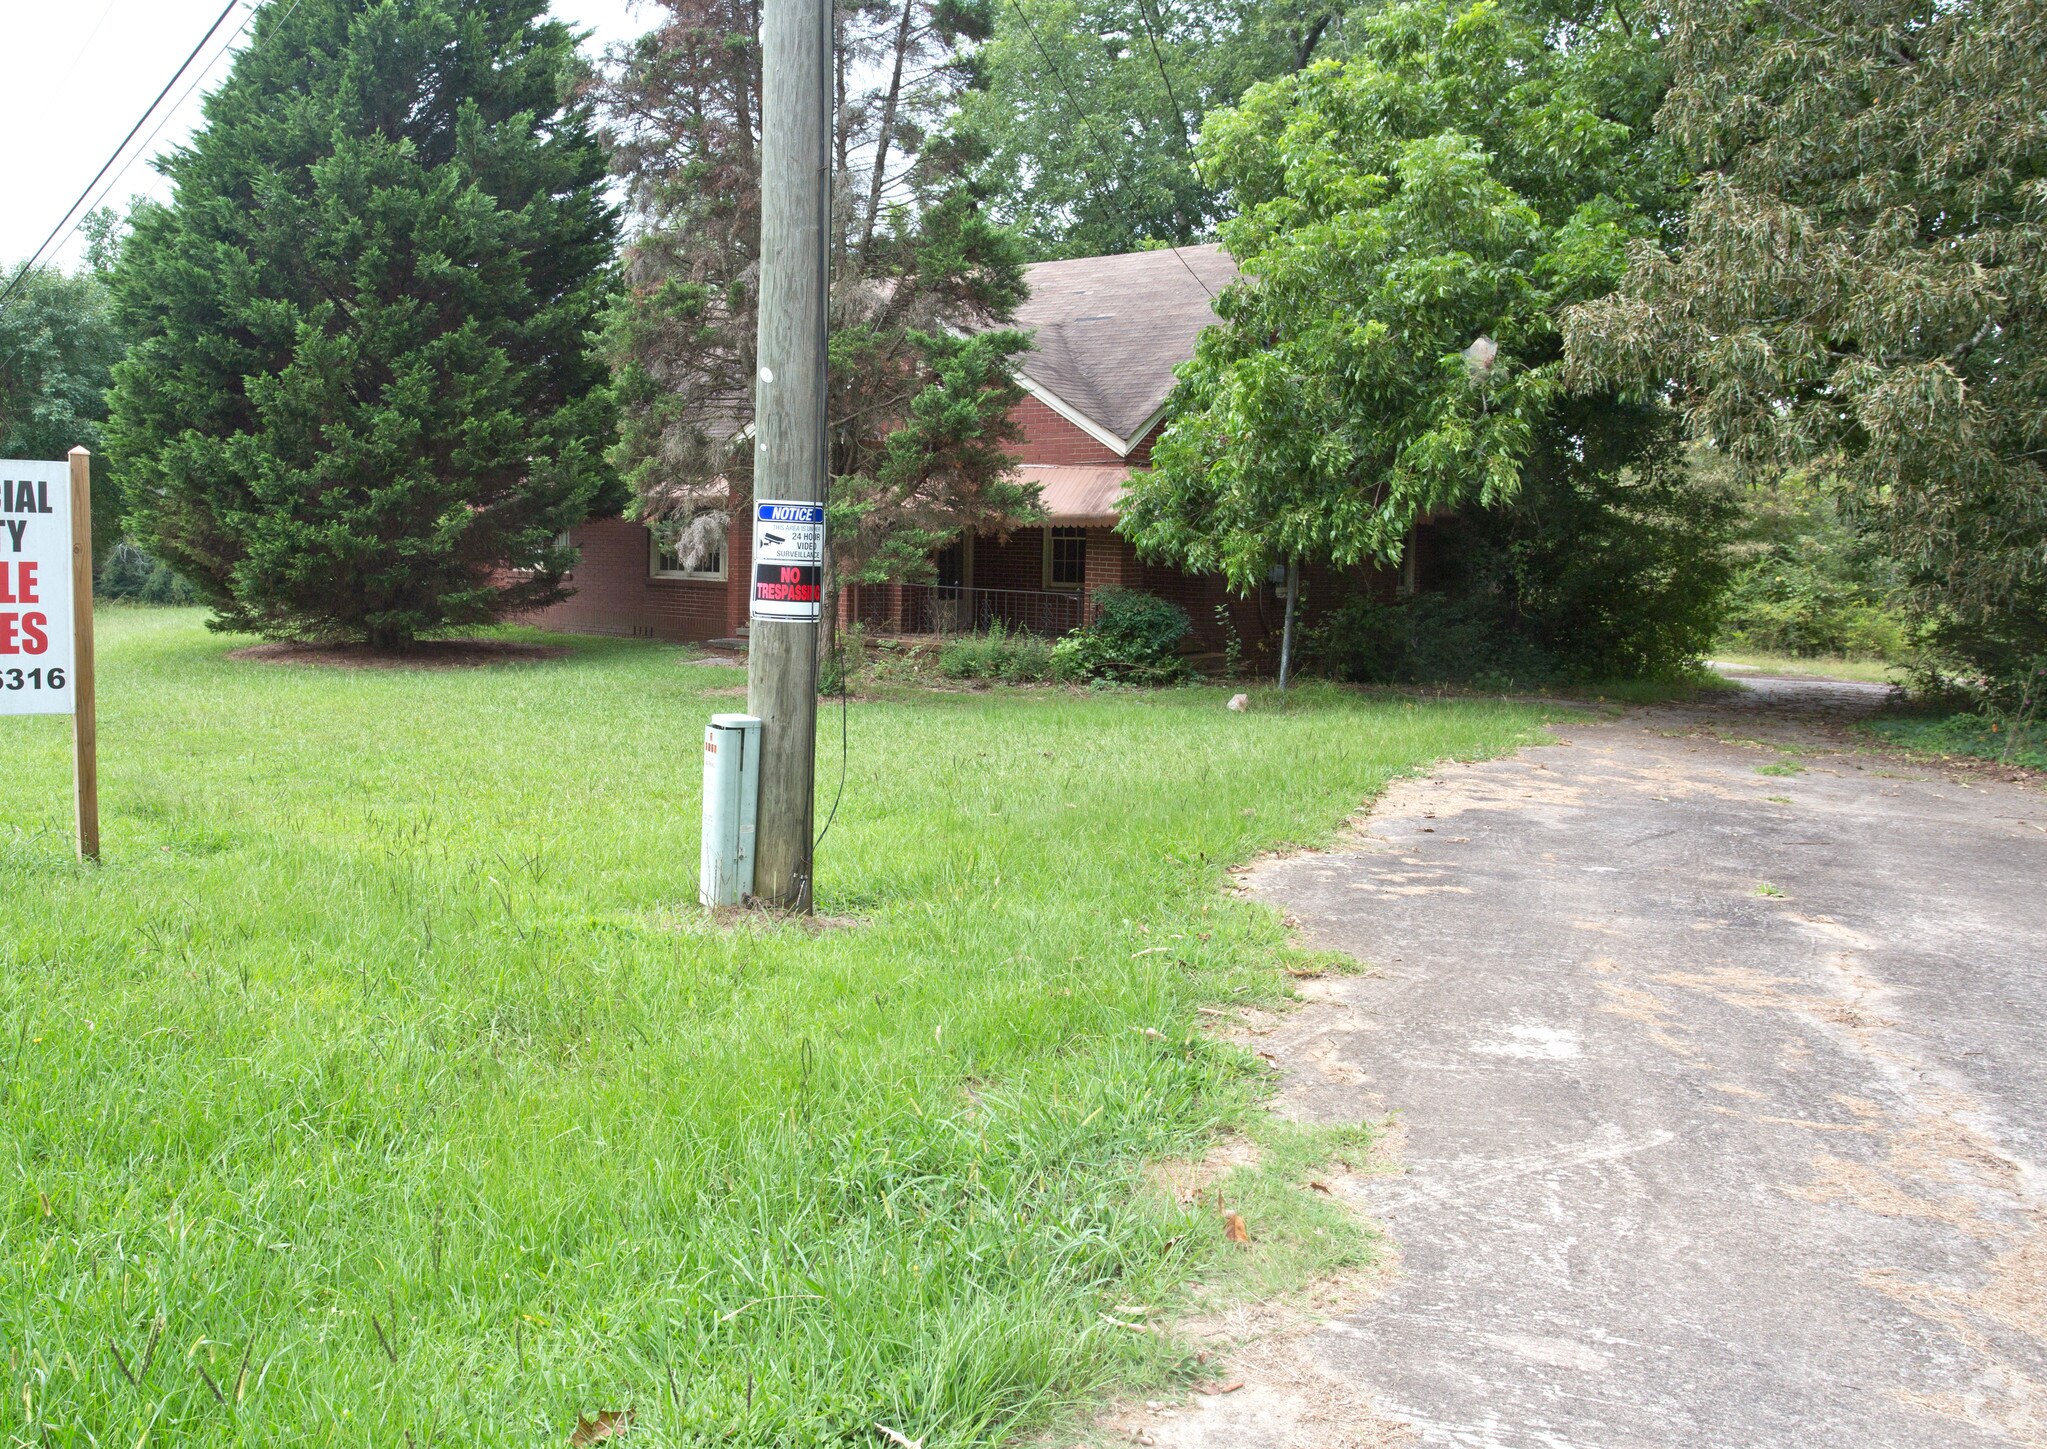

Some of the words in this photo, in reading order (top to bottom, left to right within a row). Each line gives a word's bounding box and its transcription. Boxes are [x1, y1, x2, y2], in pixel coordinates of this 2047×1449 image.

[0, 480, 52, 513] IAL
[771, 506, 813, 521] NOTICE
[792, 532, 802, 541] 24
[781, 567, 801, 584] NO
[0, 612, 48, 655] ES
[0, 668, 66, 690] 316
